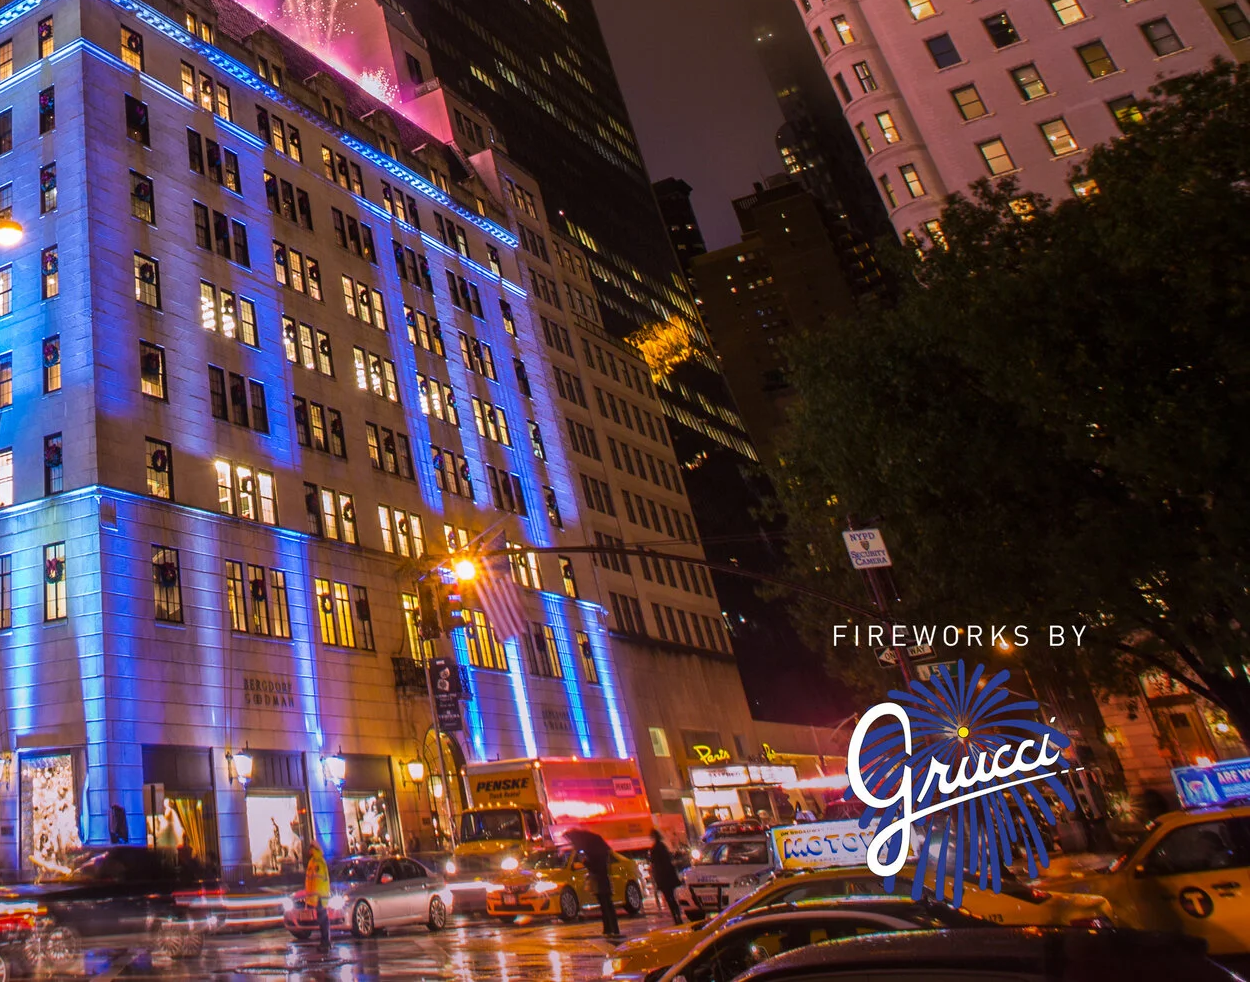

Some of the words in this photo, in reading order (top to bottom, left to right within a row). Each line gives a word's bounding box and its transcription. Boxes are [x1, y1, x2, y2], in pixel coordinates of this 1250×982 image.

[849, 532, 875, 542] NYPD
[910, 646, 925, 655] WAY
[243, 678, 292, 693] BERGDORF
[693, 745, 730, 766] Paris
[476, 777, 529, 793] PENSKE
